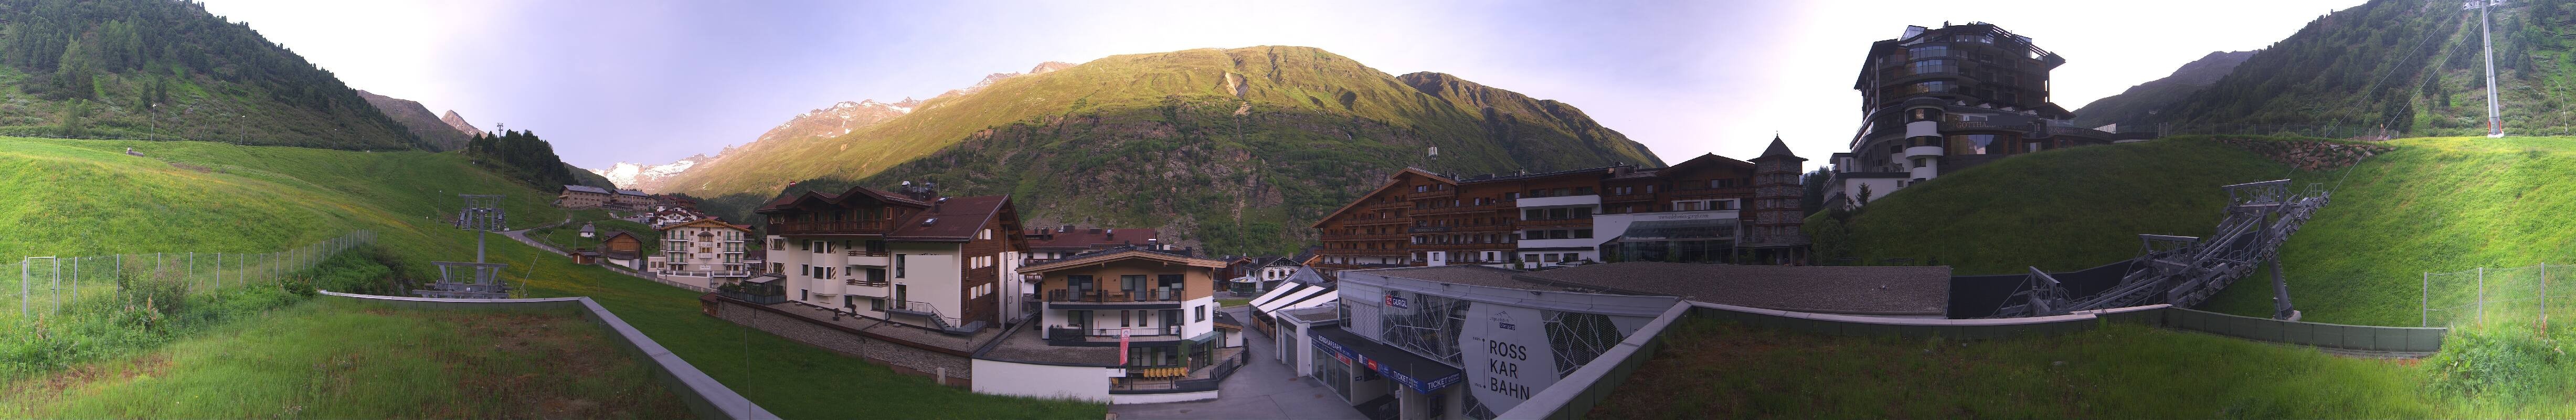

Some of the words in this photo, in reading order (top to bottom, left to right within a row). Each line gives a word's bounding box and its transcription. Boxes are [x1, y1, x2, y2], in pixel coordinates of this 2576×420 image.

[1393, 299, 1407, 307] GURGL
[1318, 335, 1342, 352] ROSSKARBAHN
[1490, 340, 1526, 361] ROSS
[1393, 371, 1409, 383] TICKET
[1490, 359, 1518, 379] KAR
[1427, 377, 1448, 390] TICKET
[1491, 377, 1530, 400] BAHN
